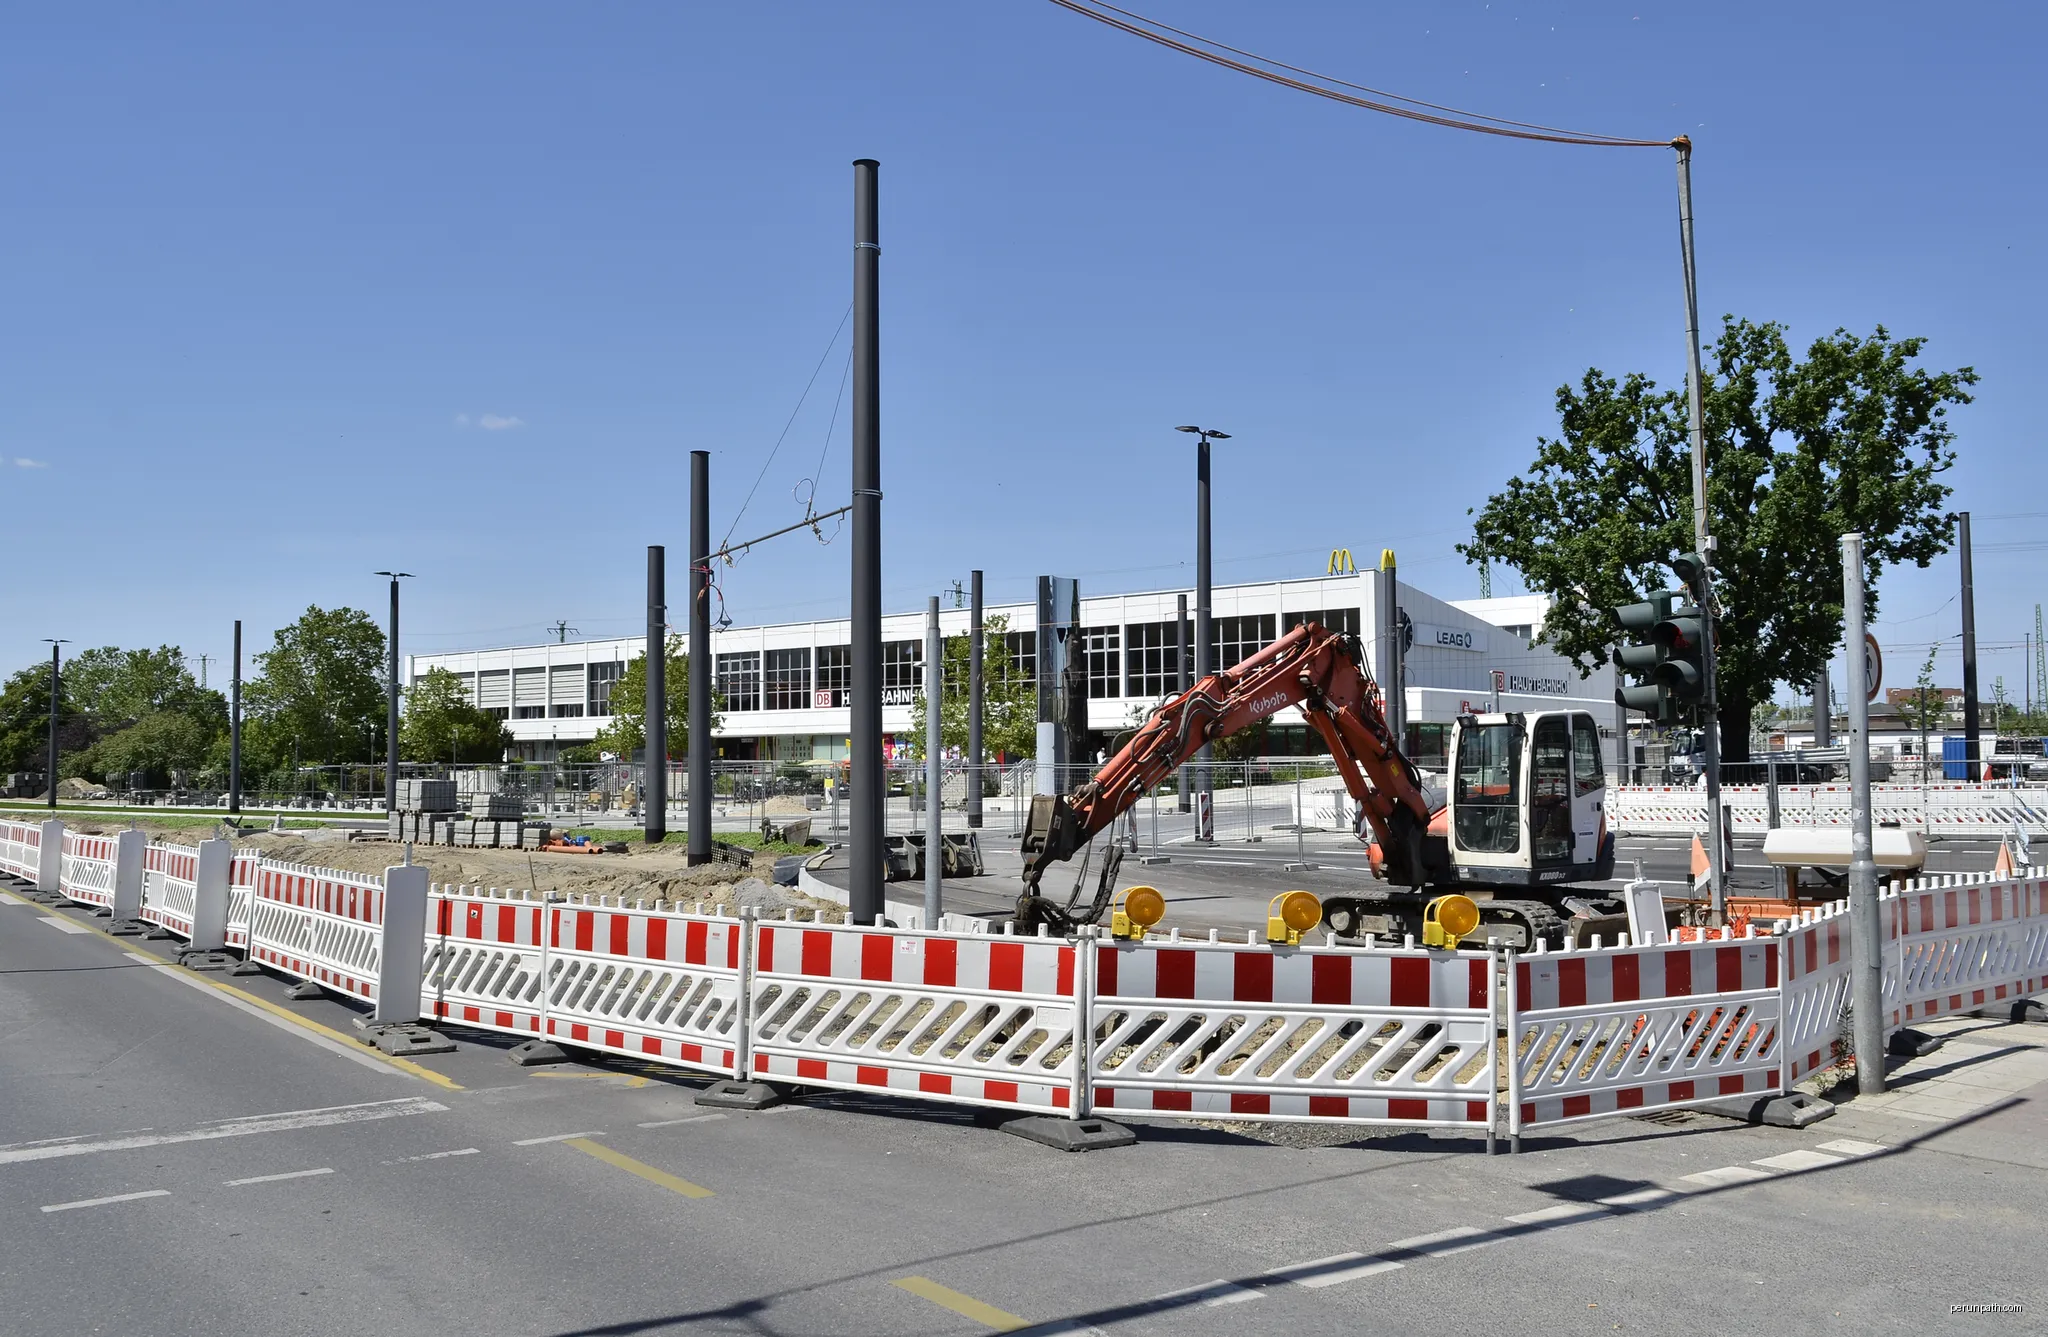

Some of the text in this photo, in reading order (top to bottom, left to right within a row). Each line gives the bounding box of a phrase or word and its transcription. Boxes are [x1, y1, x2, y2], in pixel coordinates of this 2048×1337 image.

[1436, 631, 1463, 647] LEAG
[816, 692, 831, 706] DB
[1249, 692, 1287, 713] Kubota
